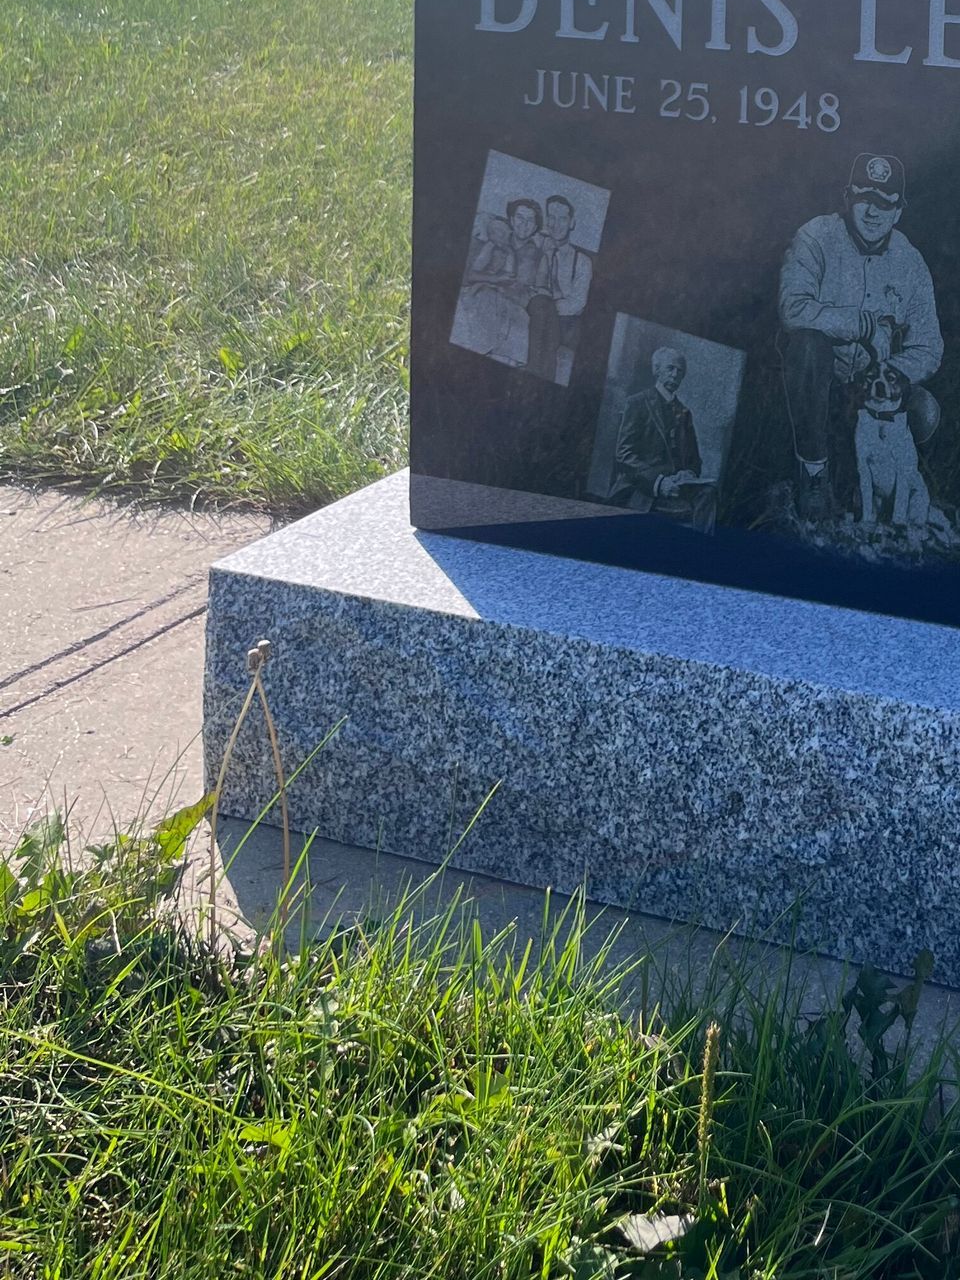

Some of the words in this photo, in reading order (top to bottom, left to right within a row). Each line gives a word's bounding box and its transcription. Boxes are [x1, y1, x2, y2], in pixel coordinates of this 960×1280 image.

[524, 69, 637, 114] JUNE
[659, 80, 718, 124] 25,
[739, 85, 841, 133] 1948
